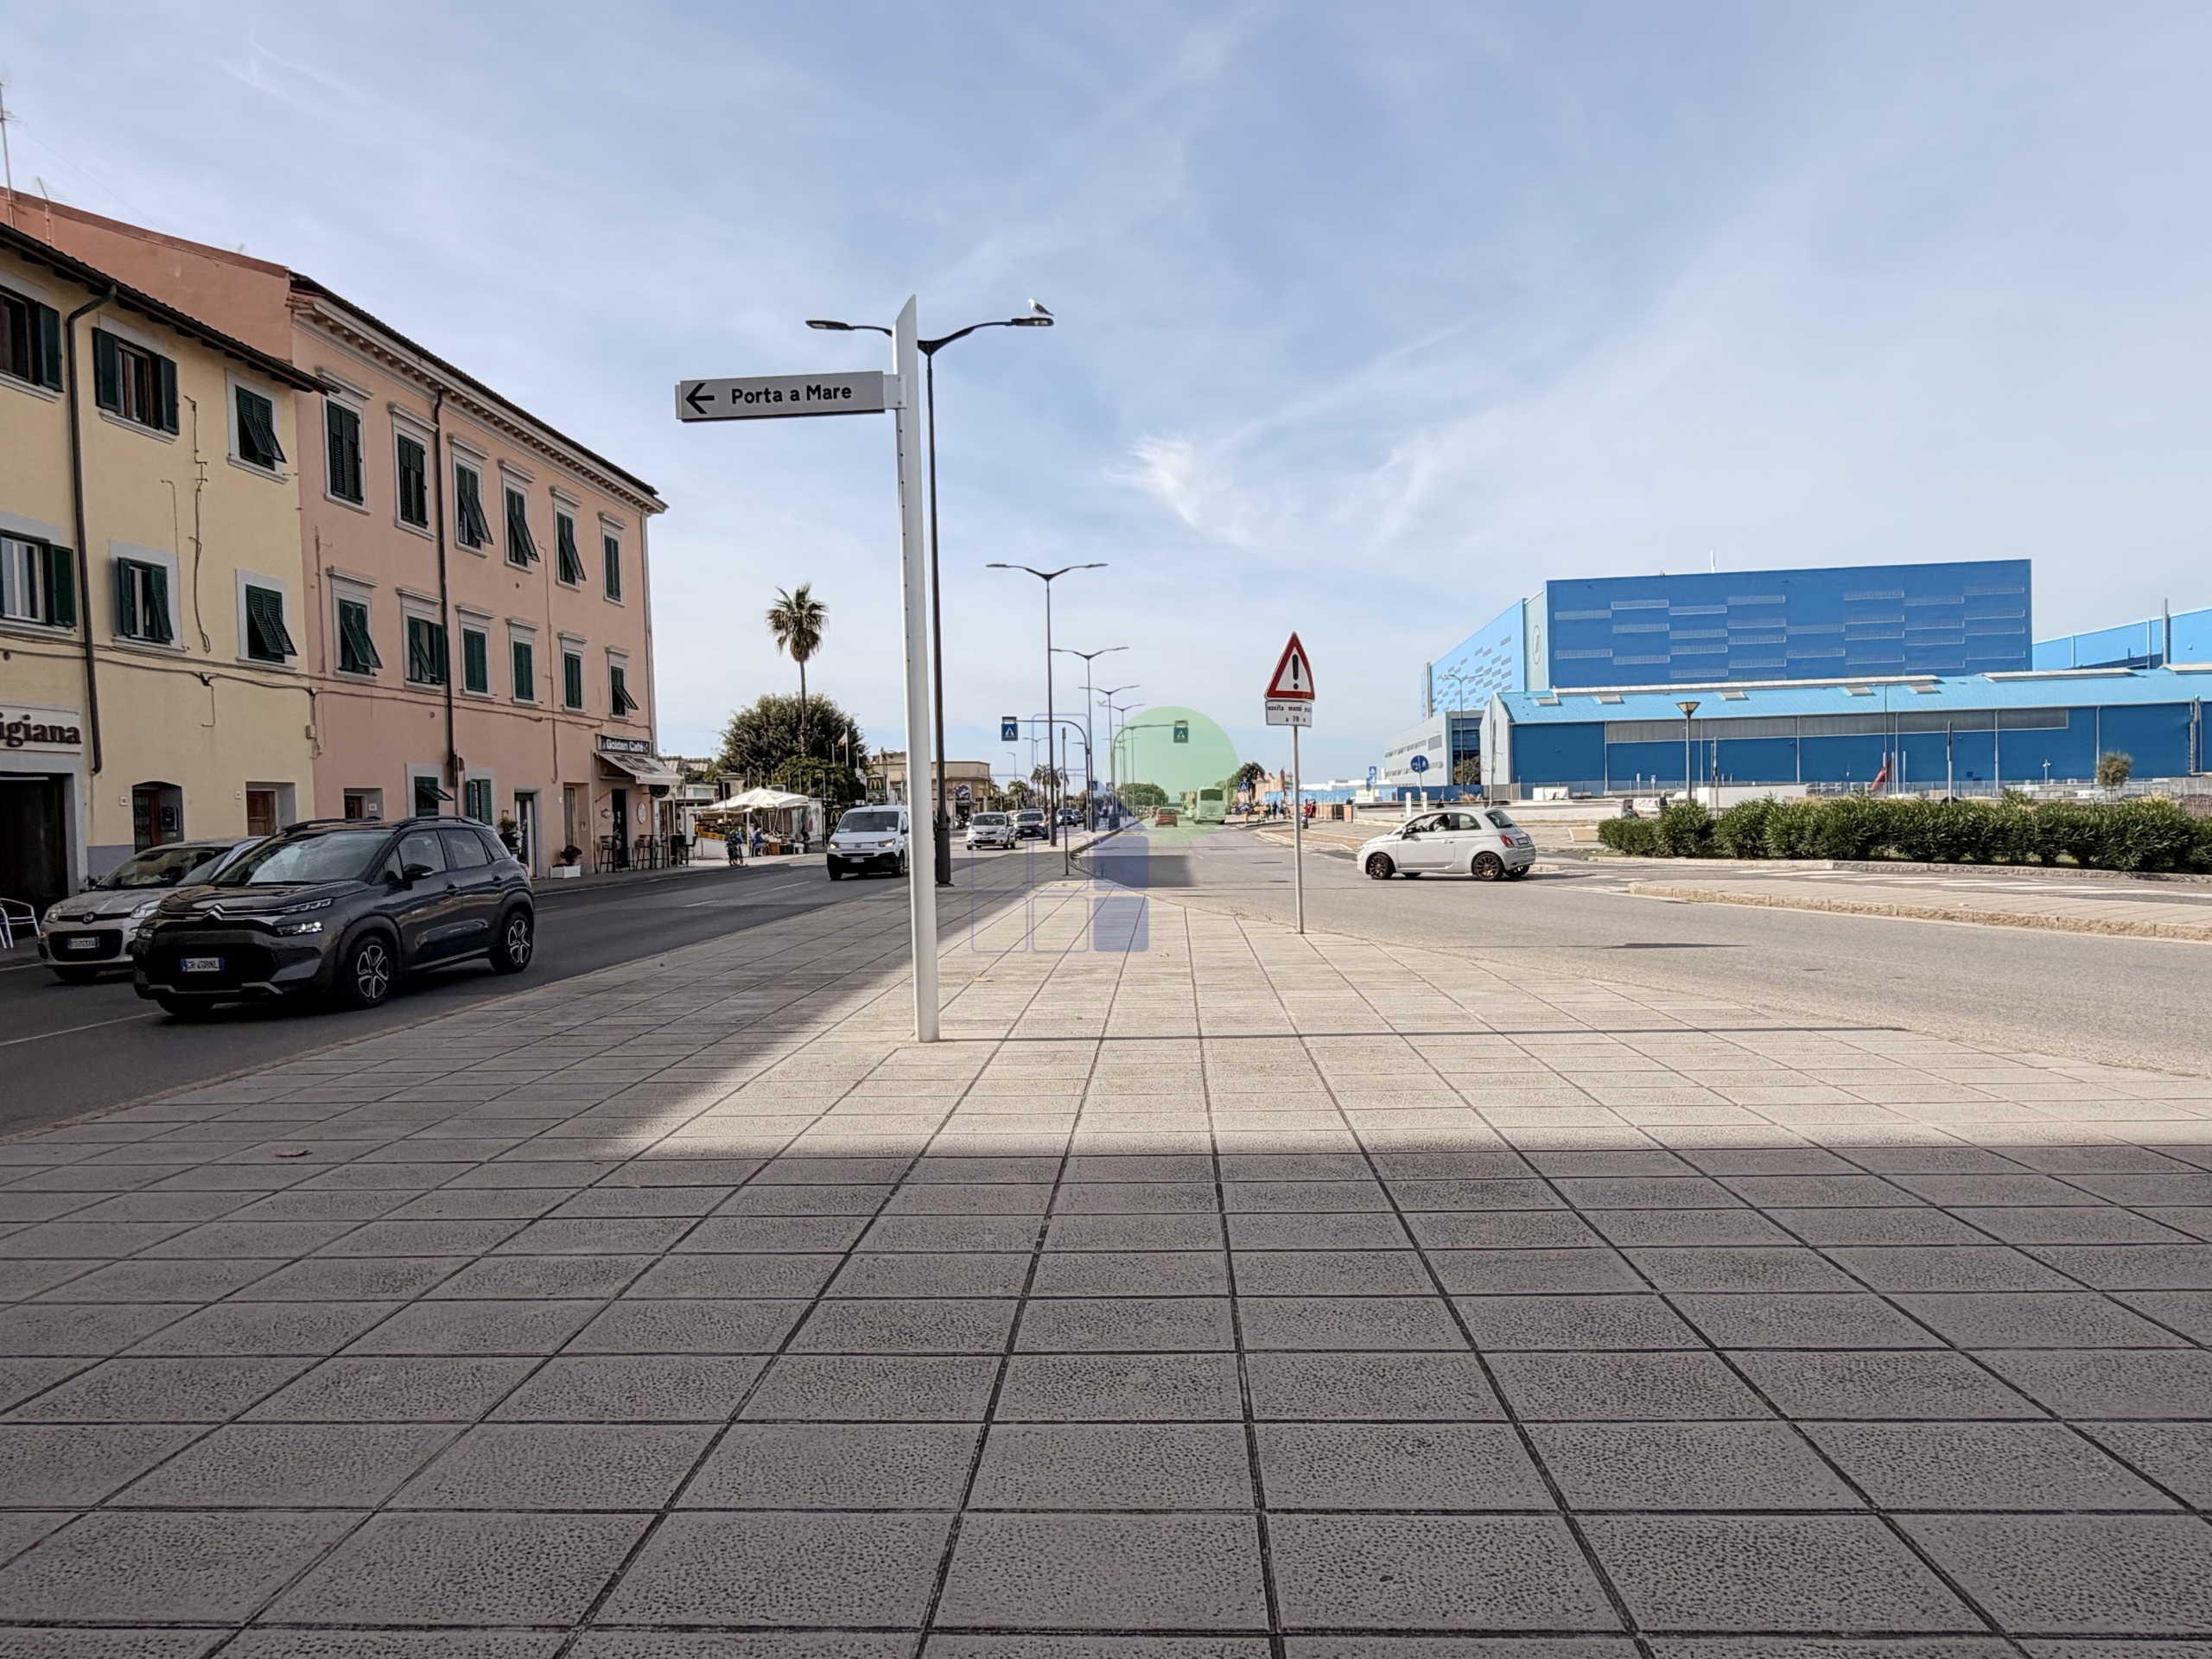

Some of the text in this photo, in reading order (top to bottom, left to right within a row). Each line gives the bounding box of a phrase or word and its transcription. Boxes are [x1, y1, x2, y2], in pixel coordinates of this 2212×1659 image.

[731, 385, 852, 404] Porta a Mare
[606, 739, 629, 751] Golden
